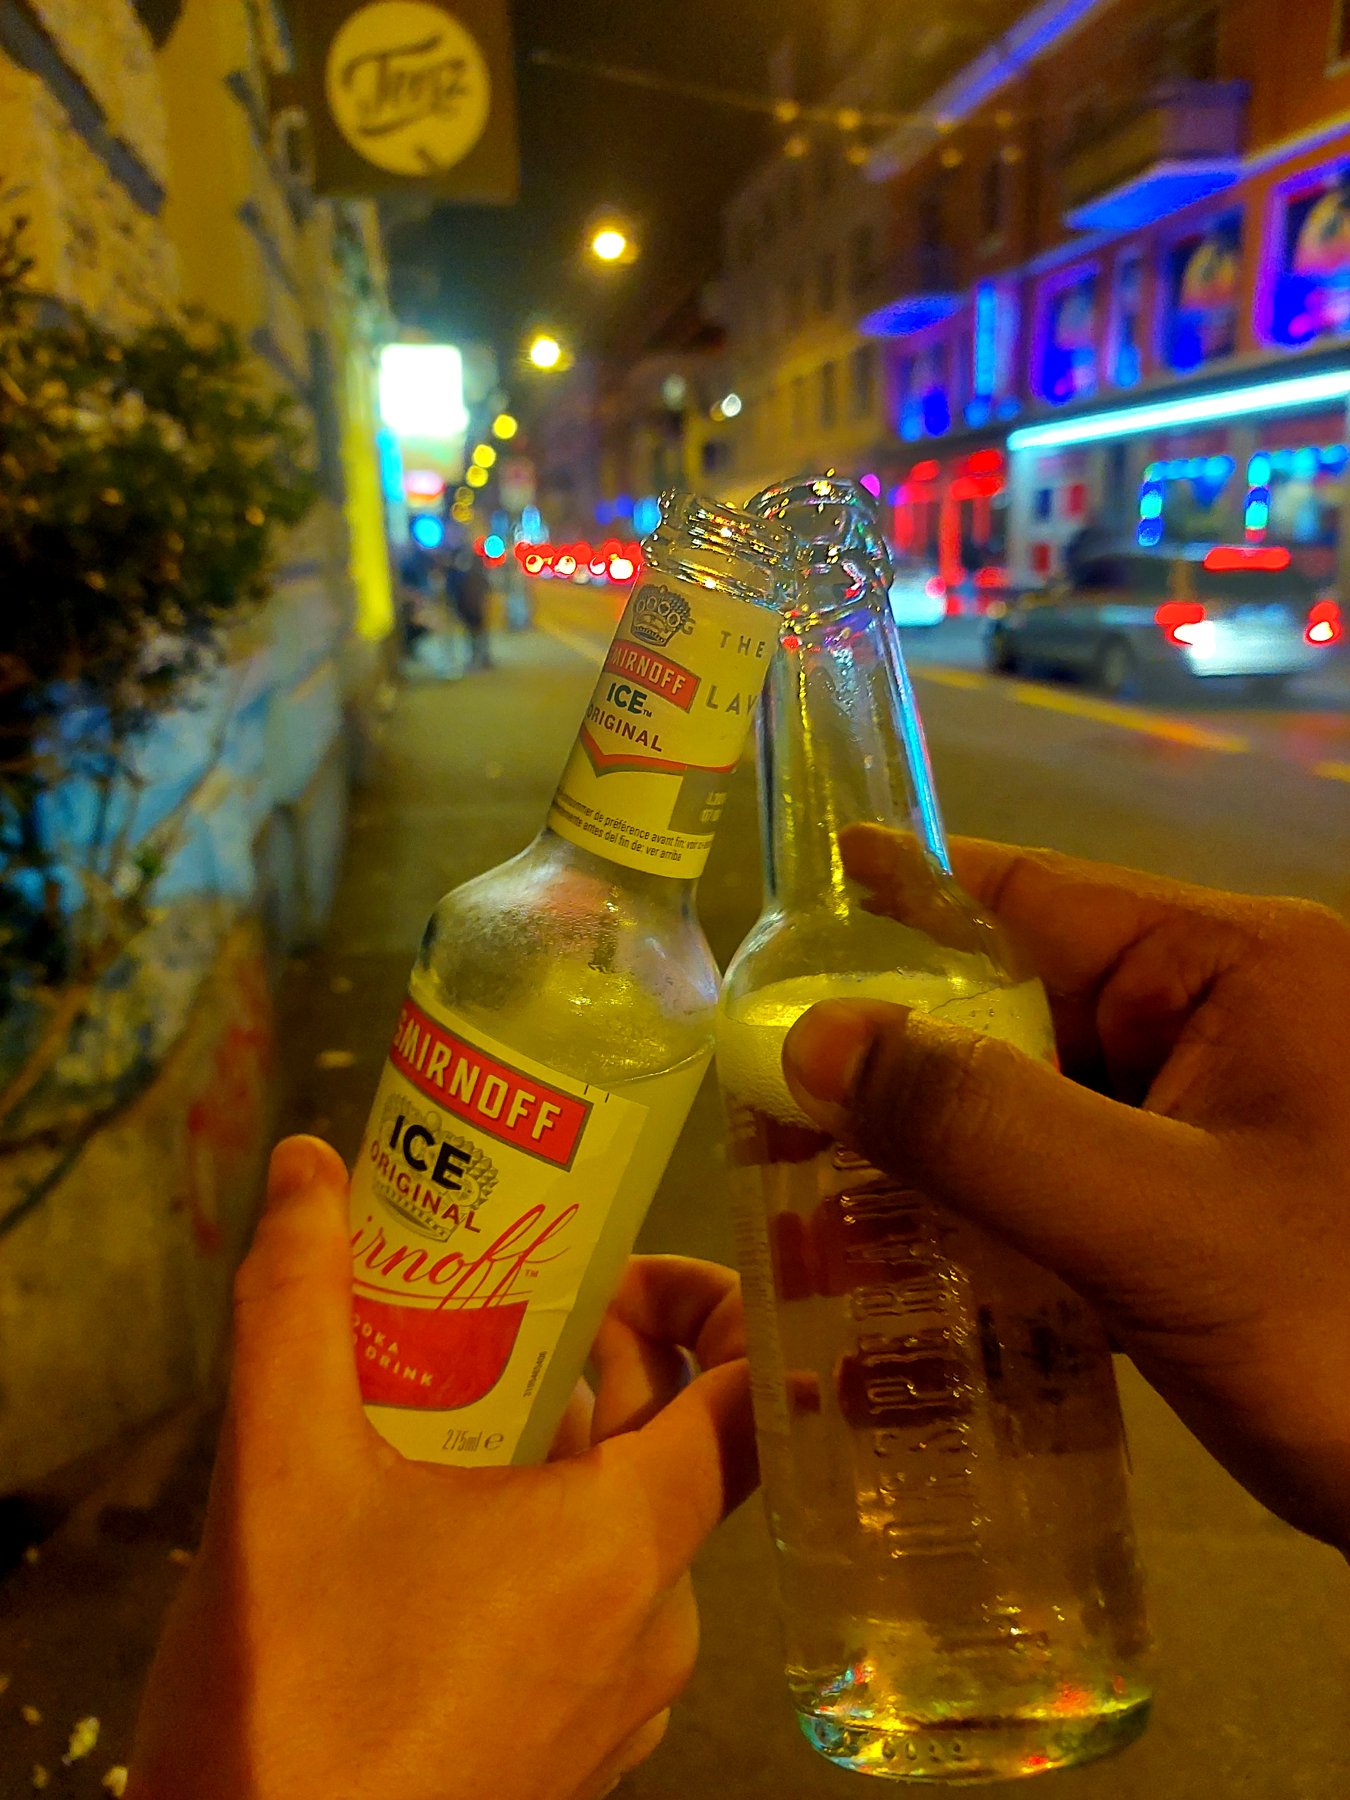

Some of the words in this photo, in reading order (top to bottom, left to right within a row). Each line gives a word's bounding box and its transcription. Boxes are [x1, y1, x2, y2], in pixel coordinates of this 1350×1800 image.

[719, 629, 766, 658] THE
[607, 646, 687, 696] MIRNOFF
[606, 682, 648, 715] ICE
[586, 703, 663, 753] ORIGINAL
[583, 820, 603, 838] antes
[604, 829, 618, 843] del
[645, 845, 660, 858] ver
[604, 816, 650, 841] préférence
[651, 833, 674, 847] avant
[389, 1114, 473, 1192] ICE
[370, 1140, 482, 1233] ORIGINAL
[364, 1344, 434, 1387] DRINK
